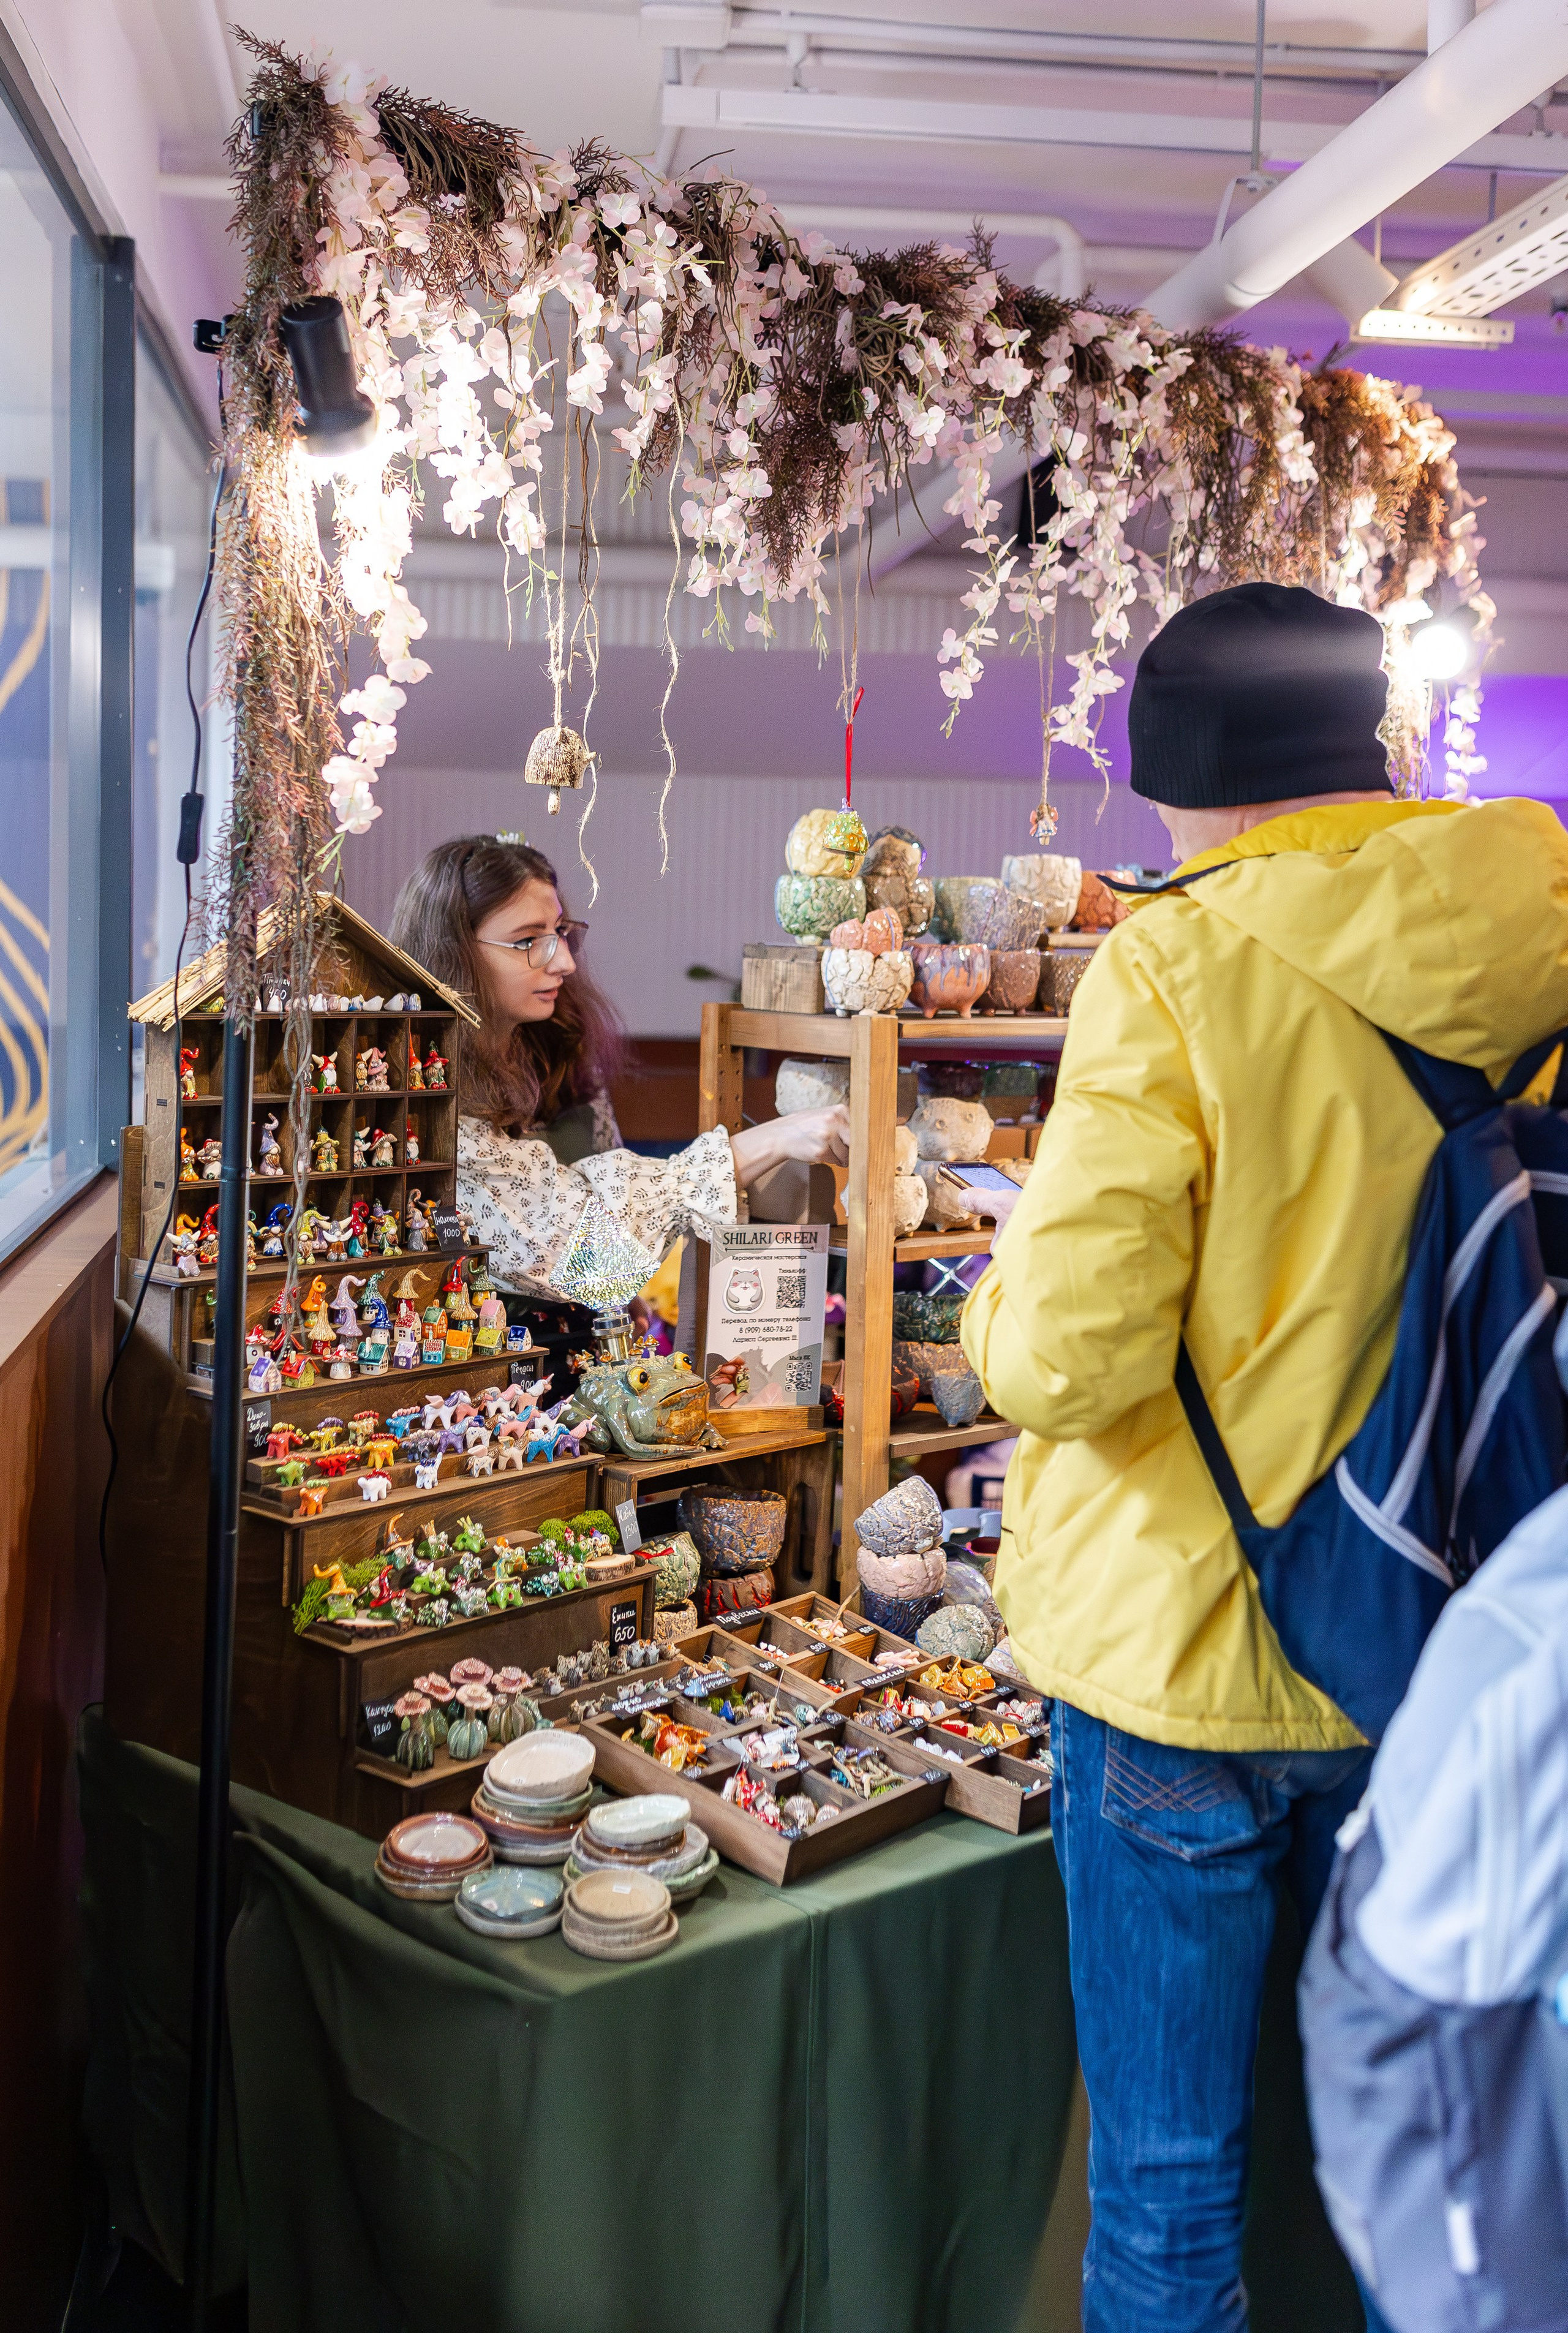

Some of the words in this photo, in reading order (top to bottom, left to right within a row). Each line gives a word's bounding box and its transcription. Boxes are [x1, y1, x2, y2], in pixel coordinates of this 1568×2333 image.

[442, 1227, 461, 1238] 1000
[723, 1232, 772, 1245] SHILARI
[775, 1232, 818, 1244] GREEN
[716, 1609, 761, 1624] Подвески
[615, 1626, 635, 1642] 650
